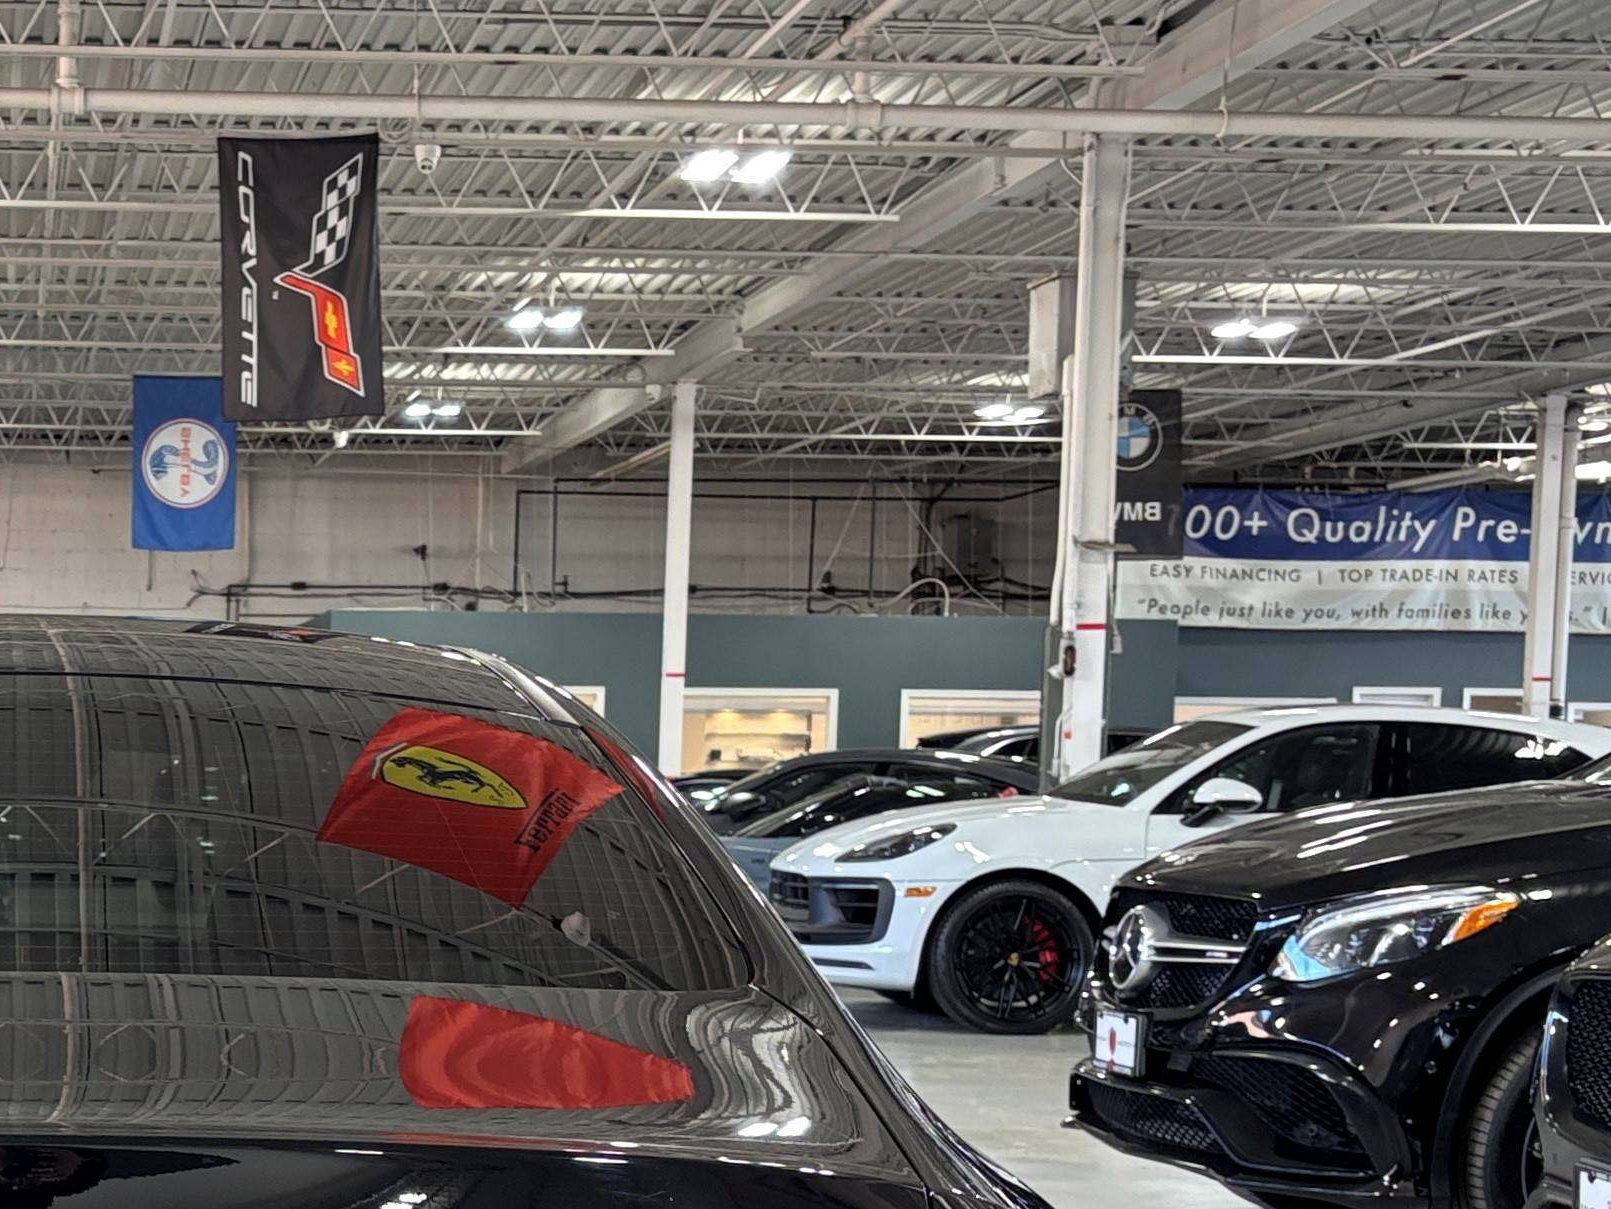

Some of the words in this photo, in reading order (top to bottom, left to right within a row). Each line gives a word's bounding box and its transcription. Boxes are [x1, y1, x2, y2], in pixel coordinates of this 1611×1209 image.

[237, 151, 258, 407] CORVETTE
[1287, 506, 1437, 553] Quality
[1149, 563, 1194, 579] EASY
[1200, 565, 1302, 583] FINANCING
[1338, 568, 1373, 583] TOP
[1380, 568, 1459, 583] TRADE-IN
[1467, 568, 1519, 584] RATES
[1217, 600, 1255, 620] just
[1260, 601, 1296, 619] like
[1301, 607, 1341, 623] you,
[1351, 602, 1389, 619] with
[1397, 601, 1472, 620] families
[1478, 602, 1513, 620] like
